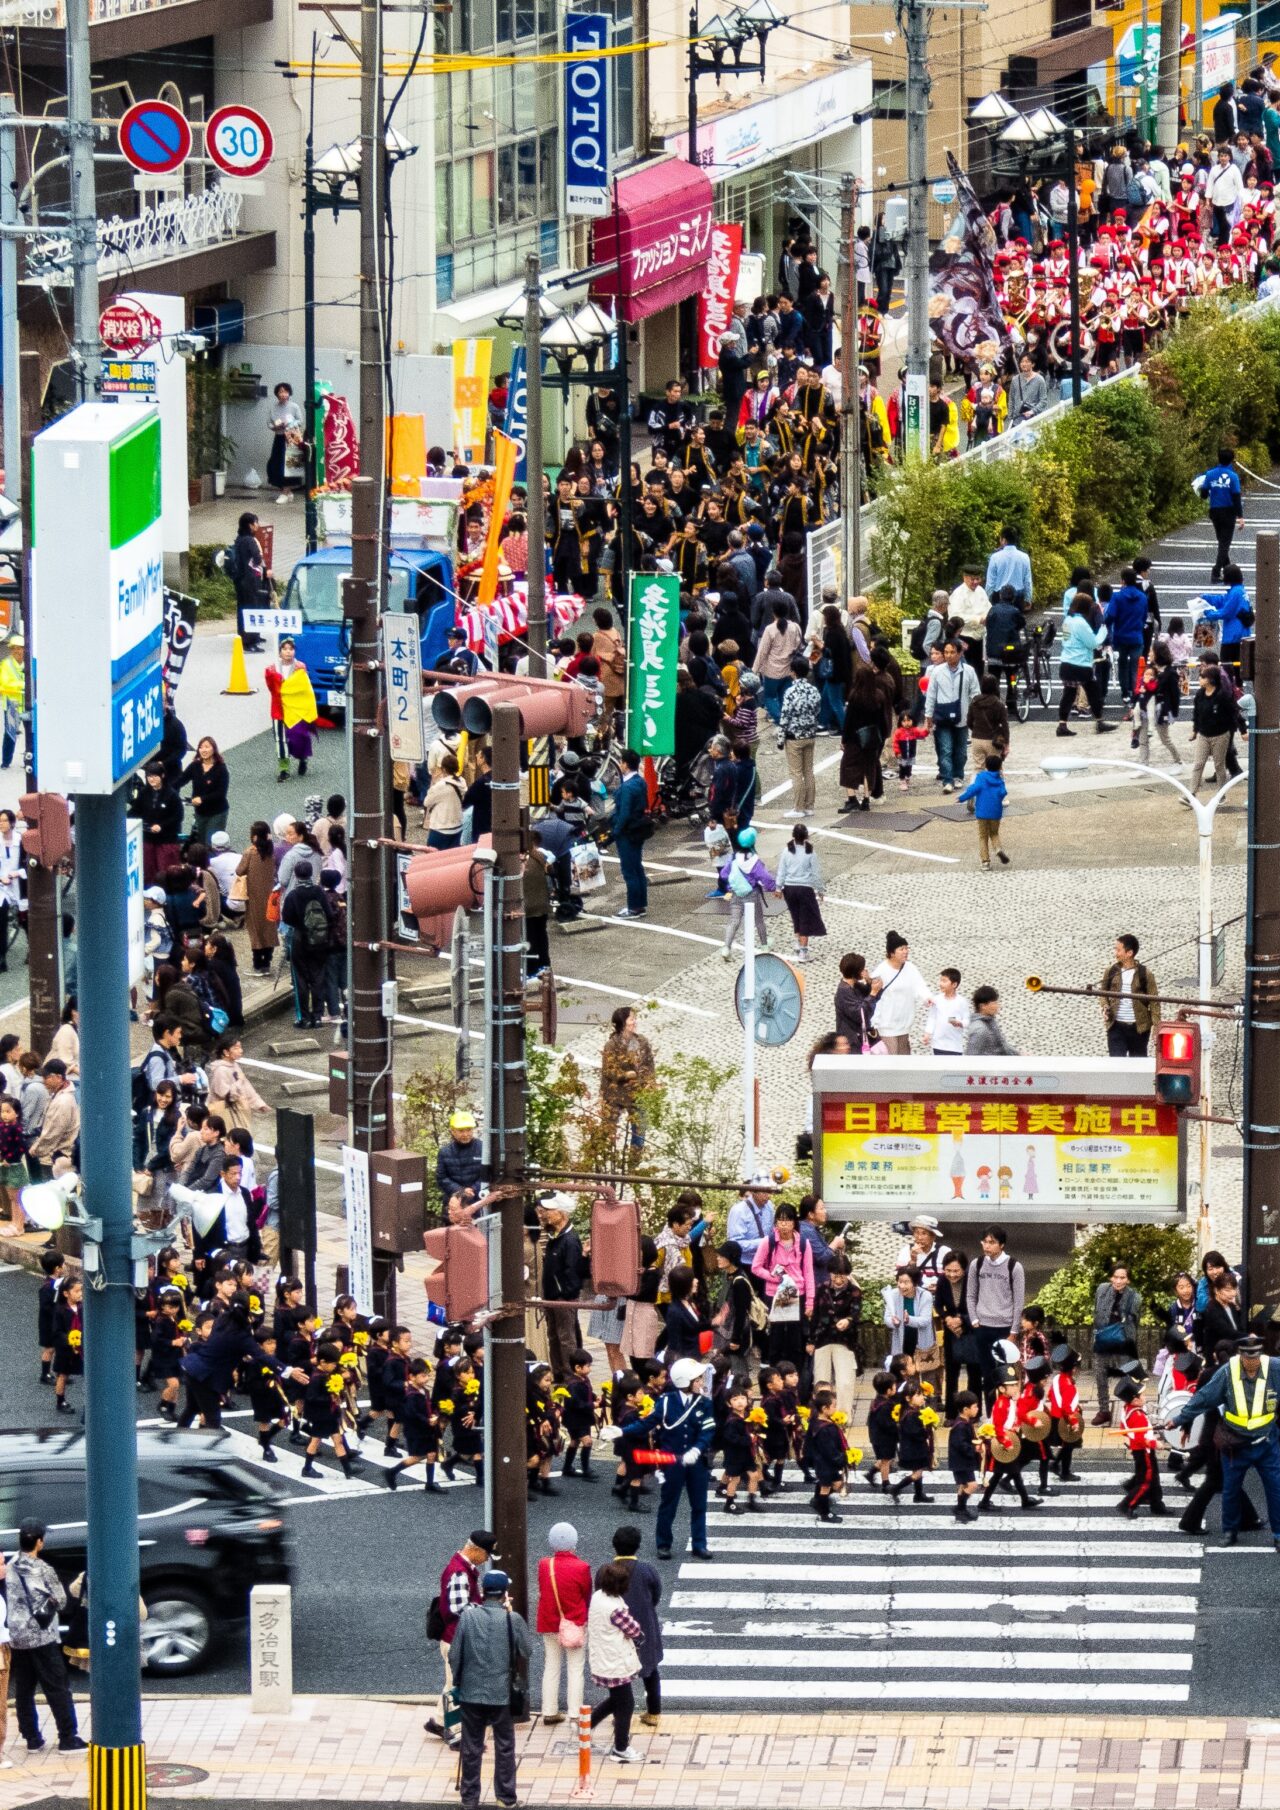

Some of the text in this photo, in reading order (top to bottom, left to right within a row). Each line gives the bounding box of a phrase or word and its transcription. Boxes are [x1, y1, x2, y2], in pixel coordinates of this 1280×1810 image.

[571, 31, 600, 168] TOTO
[222, 126, 258, 157] 30
[103, 319, 141, 338] 消火栓
[118, 557, 162, 621] FamilyMart
[121, 685, 160, 763] 酒 たばこ
[845, 1102, 1157, 1134] 日曜営業実施中
[872, 1142, 921, 1151] これは便利だね
[844, 1161, 893, 1172] 通常業務
[1063, 1163, 1111, 1174] 相談業務
[258, 1611, 280, 1688] 多治見駅
